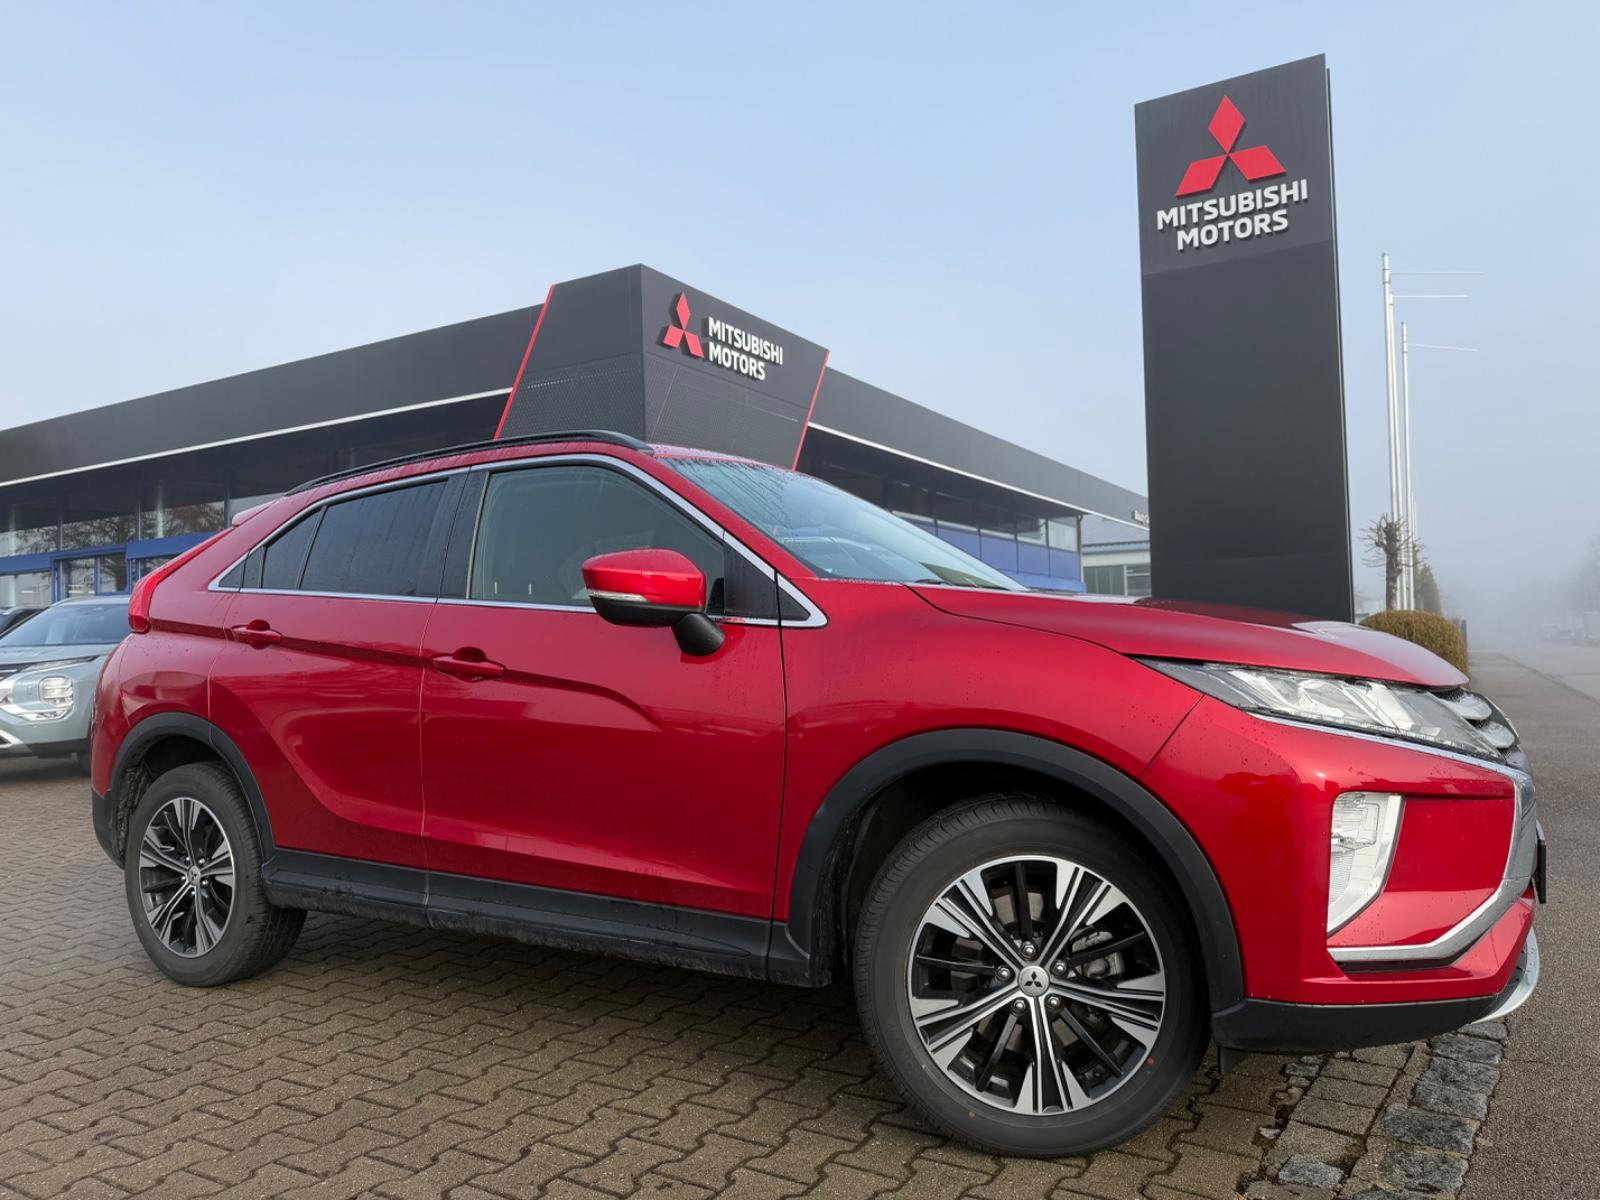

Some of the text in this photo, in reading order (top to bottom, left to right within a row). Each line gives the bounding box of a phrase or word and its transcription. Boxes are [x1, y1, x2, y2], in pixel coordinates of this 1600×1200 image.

[1156, 178, 1308, 230] MITSUBISHI
[1177, 209, 1288, 250] MOTORS
[708, 316, 784, 365] MITSUBISHI
[708, 341, 766, 380] MOTORS
